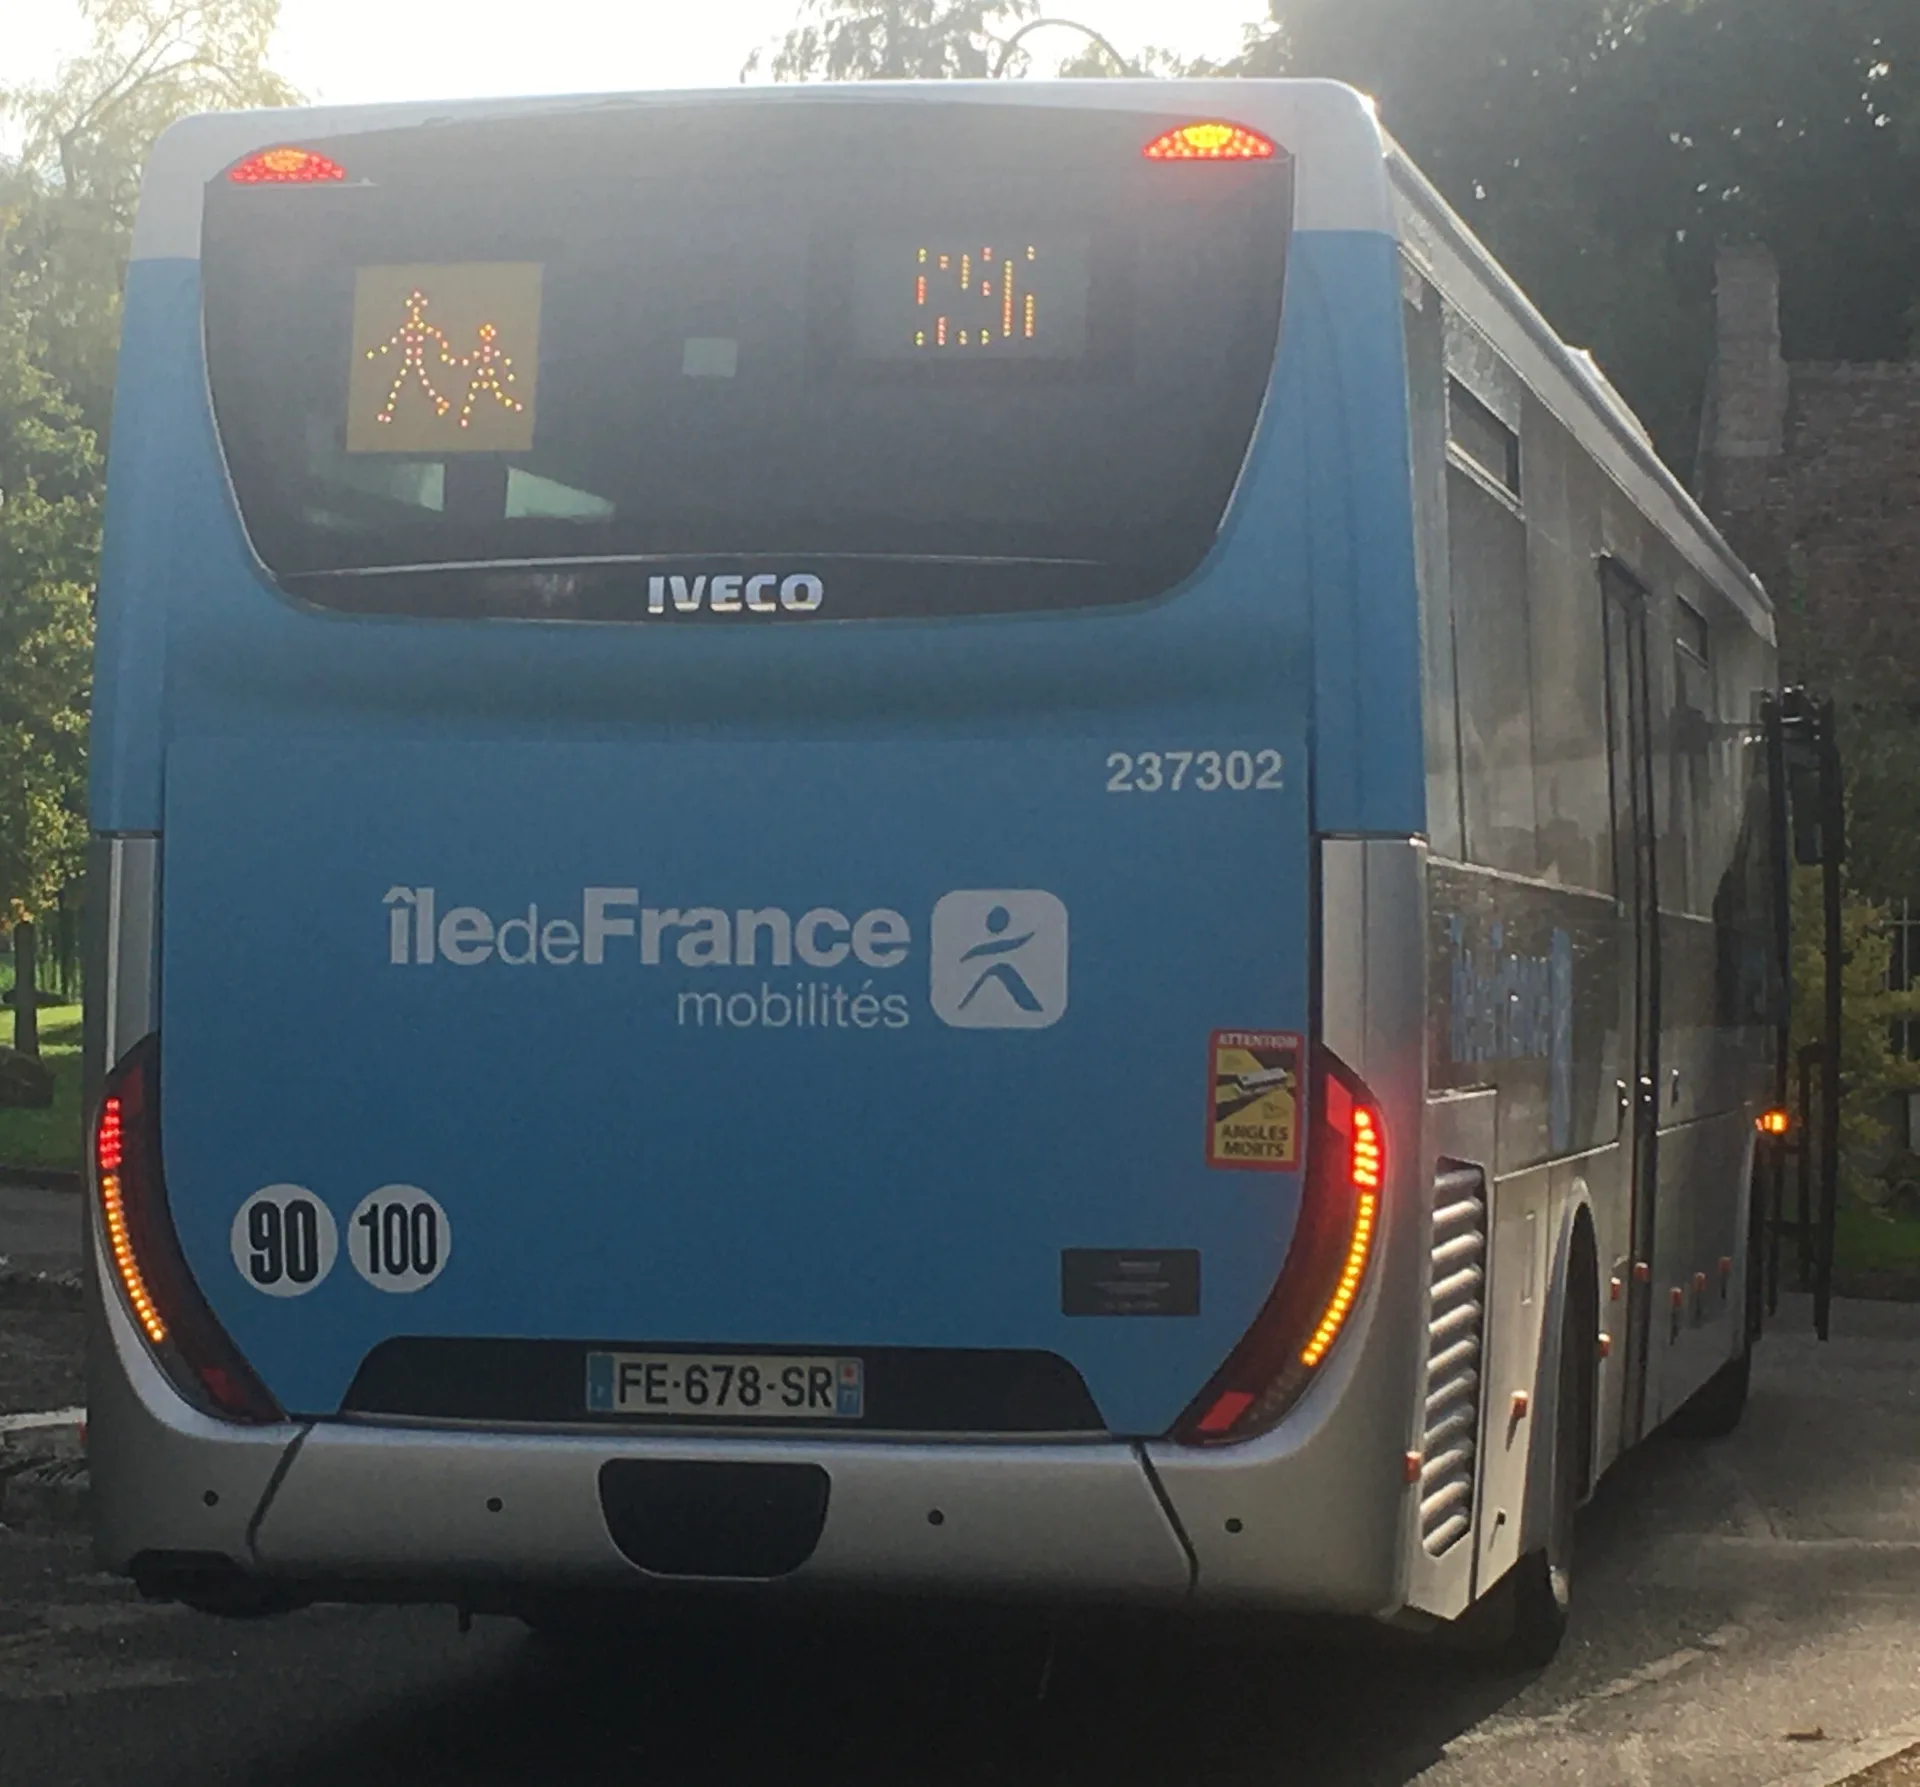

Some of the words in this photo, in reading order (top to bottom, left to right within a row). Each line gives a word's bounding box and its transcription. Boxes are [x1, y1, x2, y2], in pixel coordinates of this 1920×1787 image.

[648, 574, 824, 614] IVECO
[1106, 748, 1284, 792] 237302
[677, 979, 910, 1028] mobilités
[1222, 1123, 1289, 1141] ANGLES
[1223, 1140, 1285, 1158] MORTS
[249, 1199, 319, 1285] 90
[358, 1202, 438, 1276] 100
